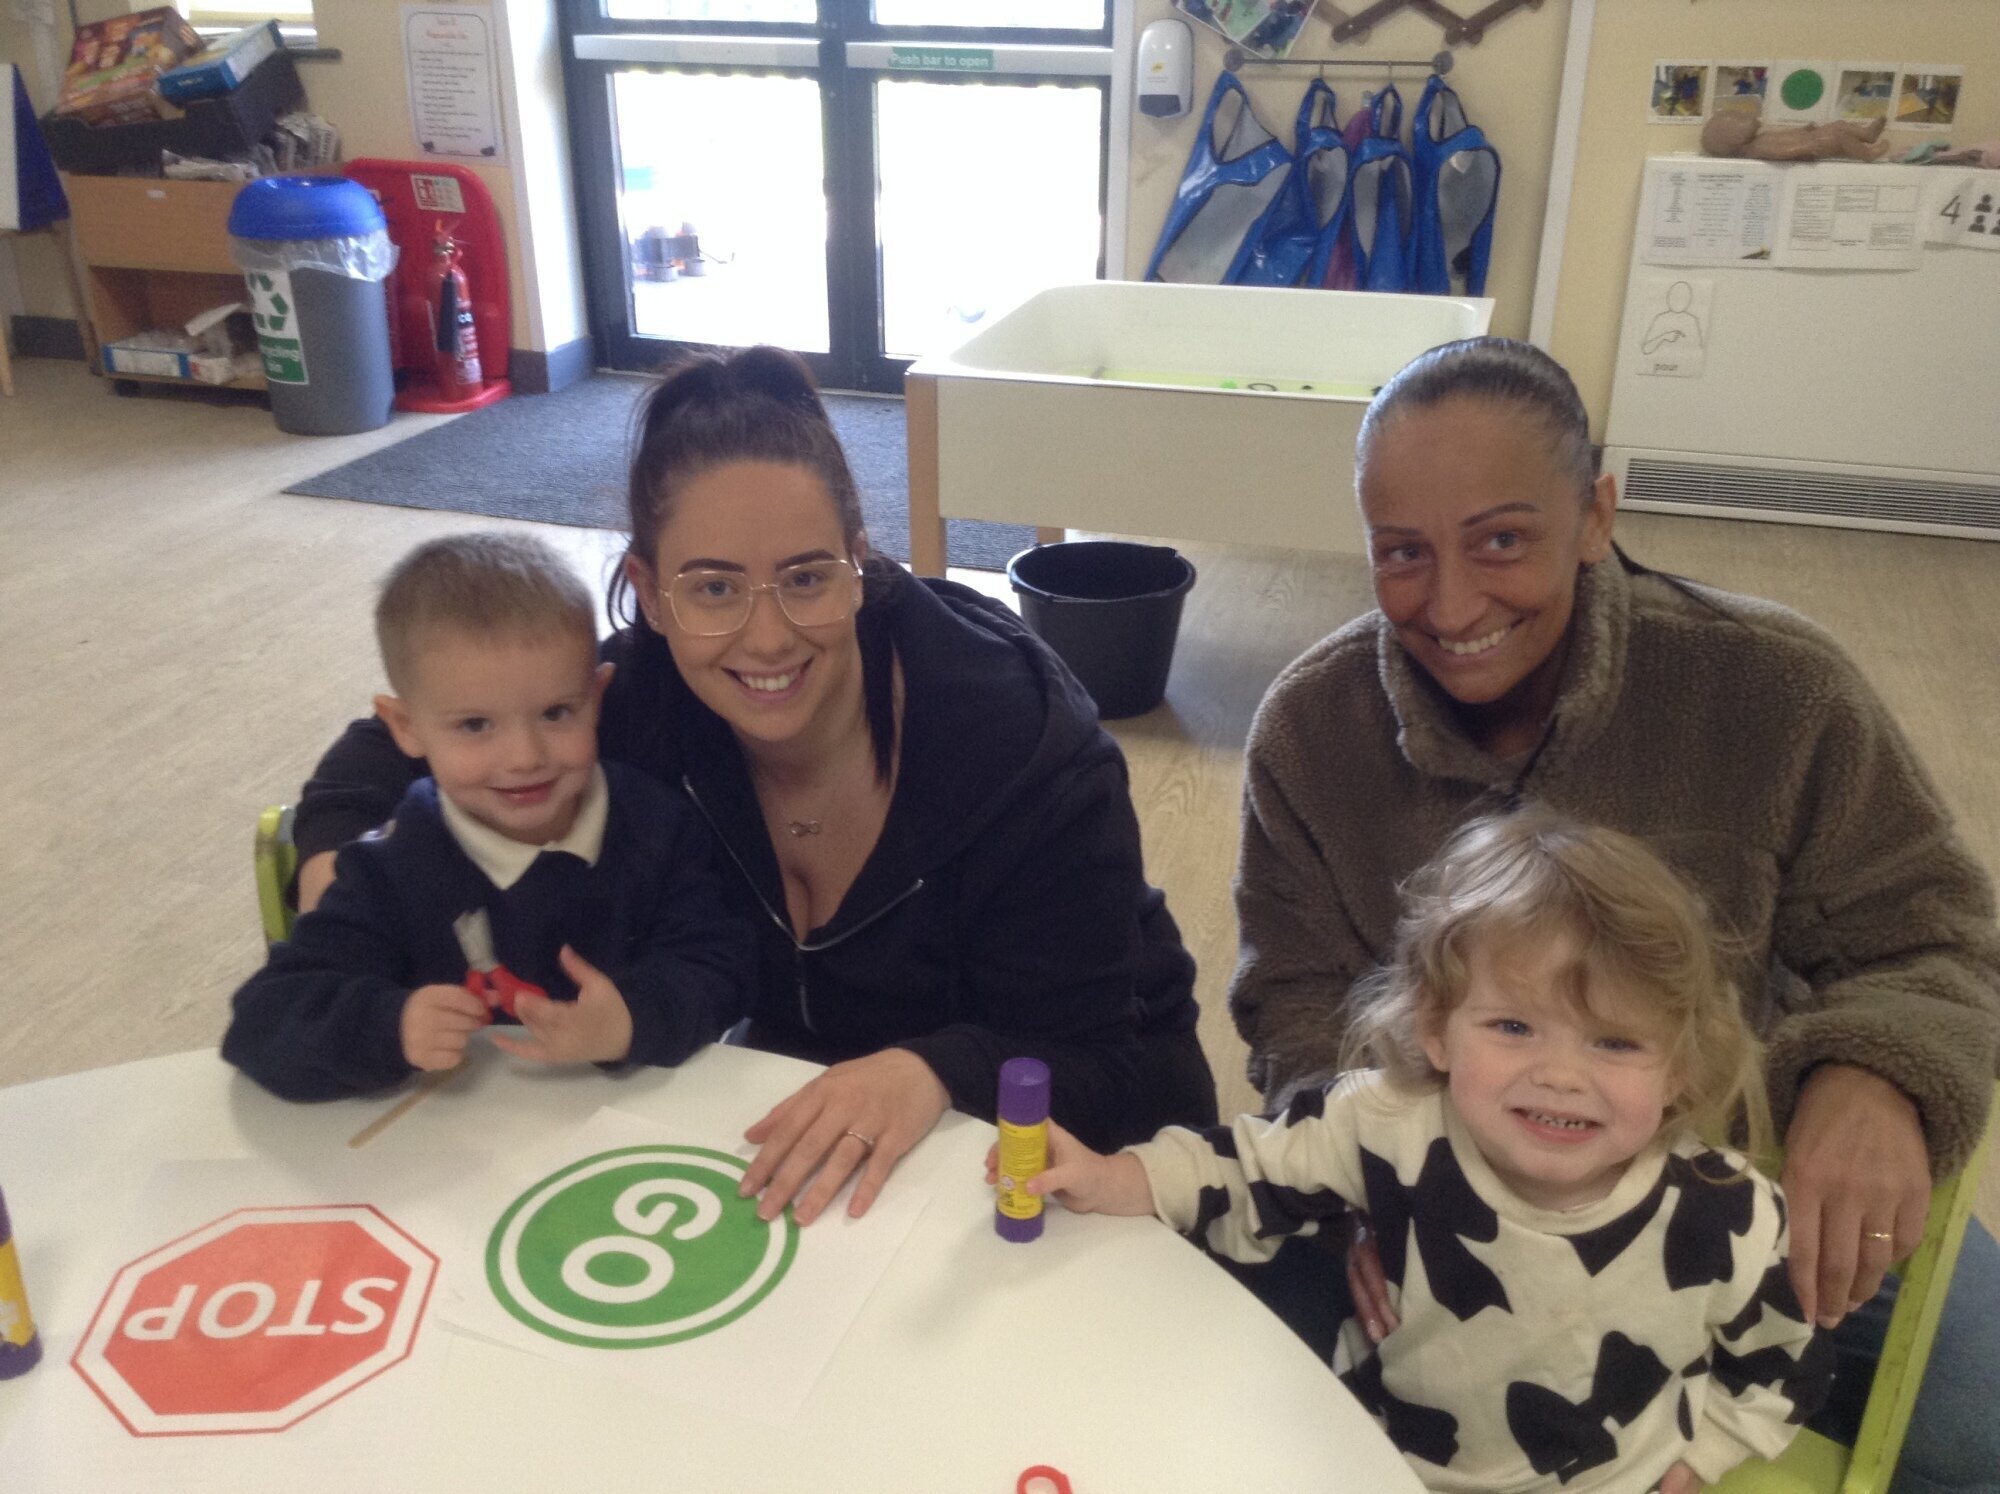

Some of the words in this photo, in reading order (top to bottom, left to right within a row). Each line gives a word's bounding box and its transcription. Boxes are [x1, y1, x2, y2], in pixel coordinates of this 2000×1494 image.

[890, 53, 920, 65] Push
[922, 55, 942, 65] bar
[944, 56, 957, 66] to
[959, 58, 989, 69] open
[1940, 194, 1961, 225] 4
[561, 1178, 723, 1304] GO
[122, 1277, 399, 1341] STOP
